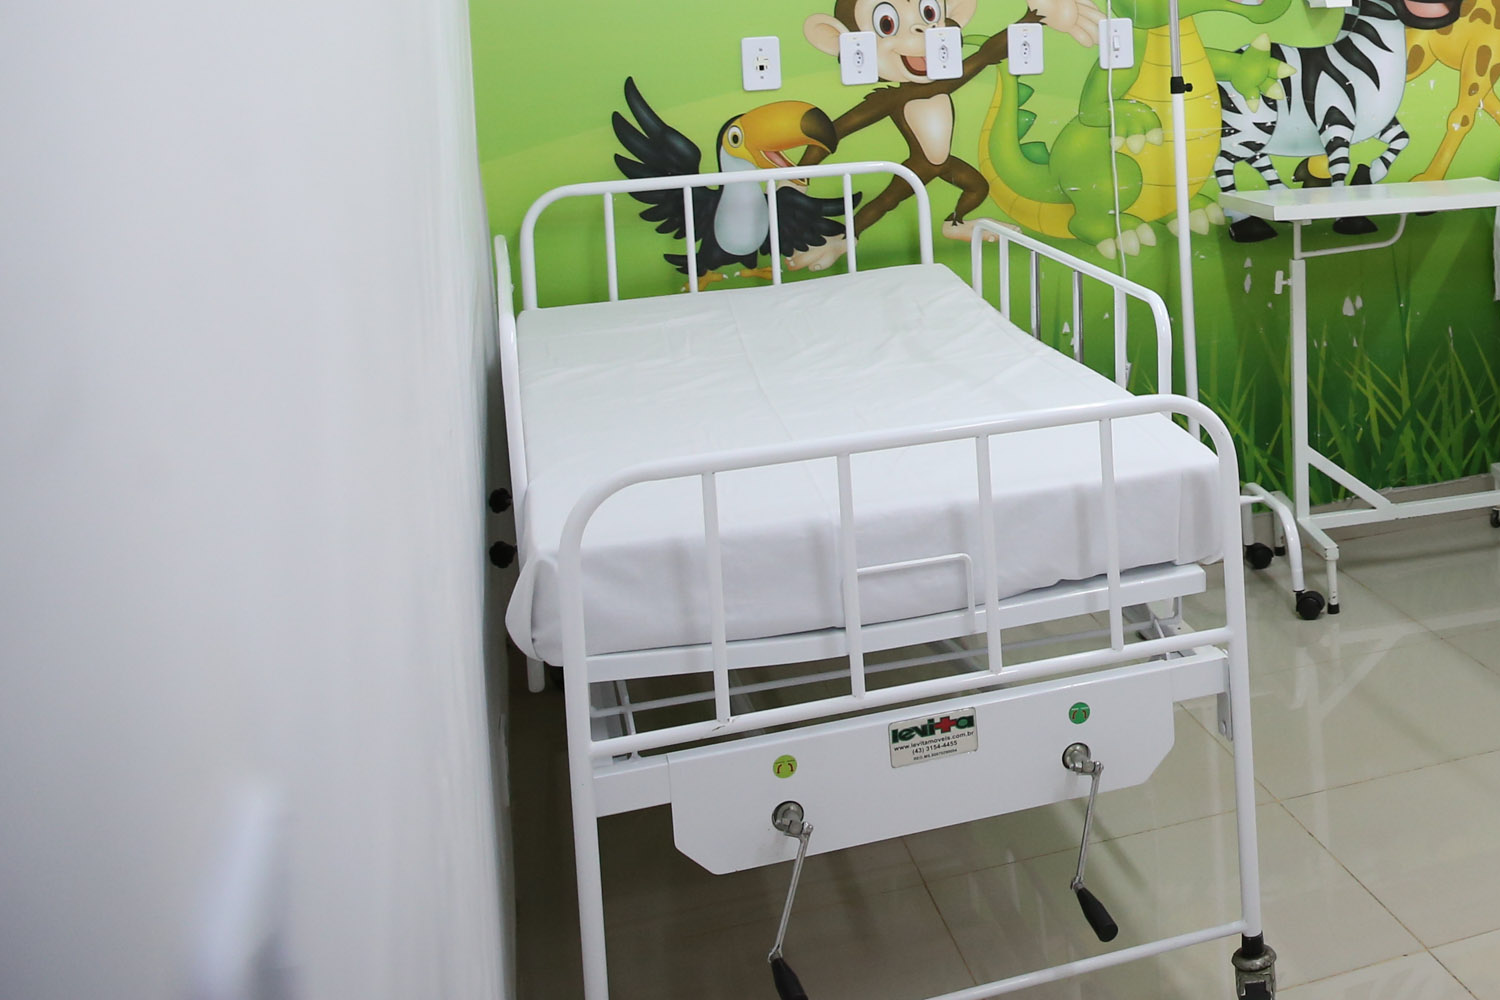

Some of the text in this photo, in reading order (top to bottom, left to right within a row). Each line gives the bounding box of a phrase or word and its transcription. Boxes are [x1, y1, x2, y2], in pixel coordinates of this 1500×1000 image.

[891, 715, 974, 744] levita
[894, 731, 974, 751] www.levitamoveis.com.br
[912, 747, 925, 755] (43)
[926, 740, 958, 752] 3154-4455
